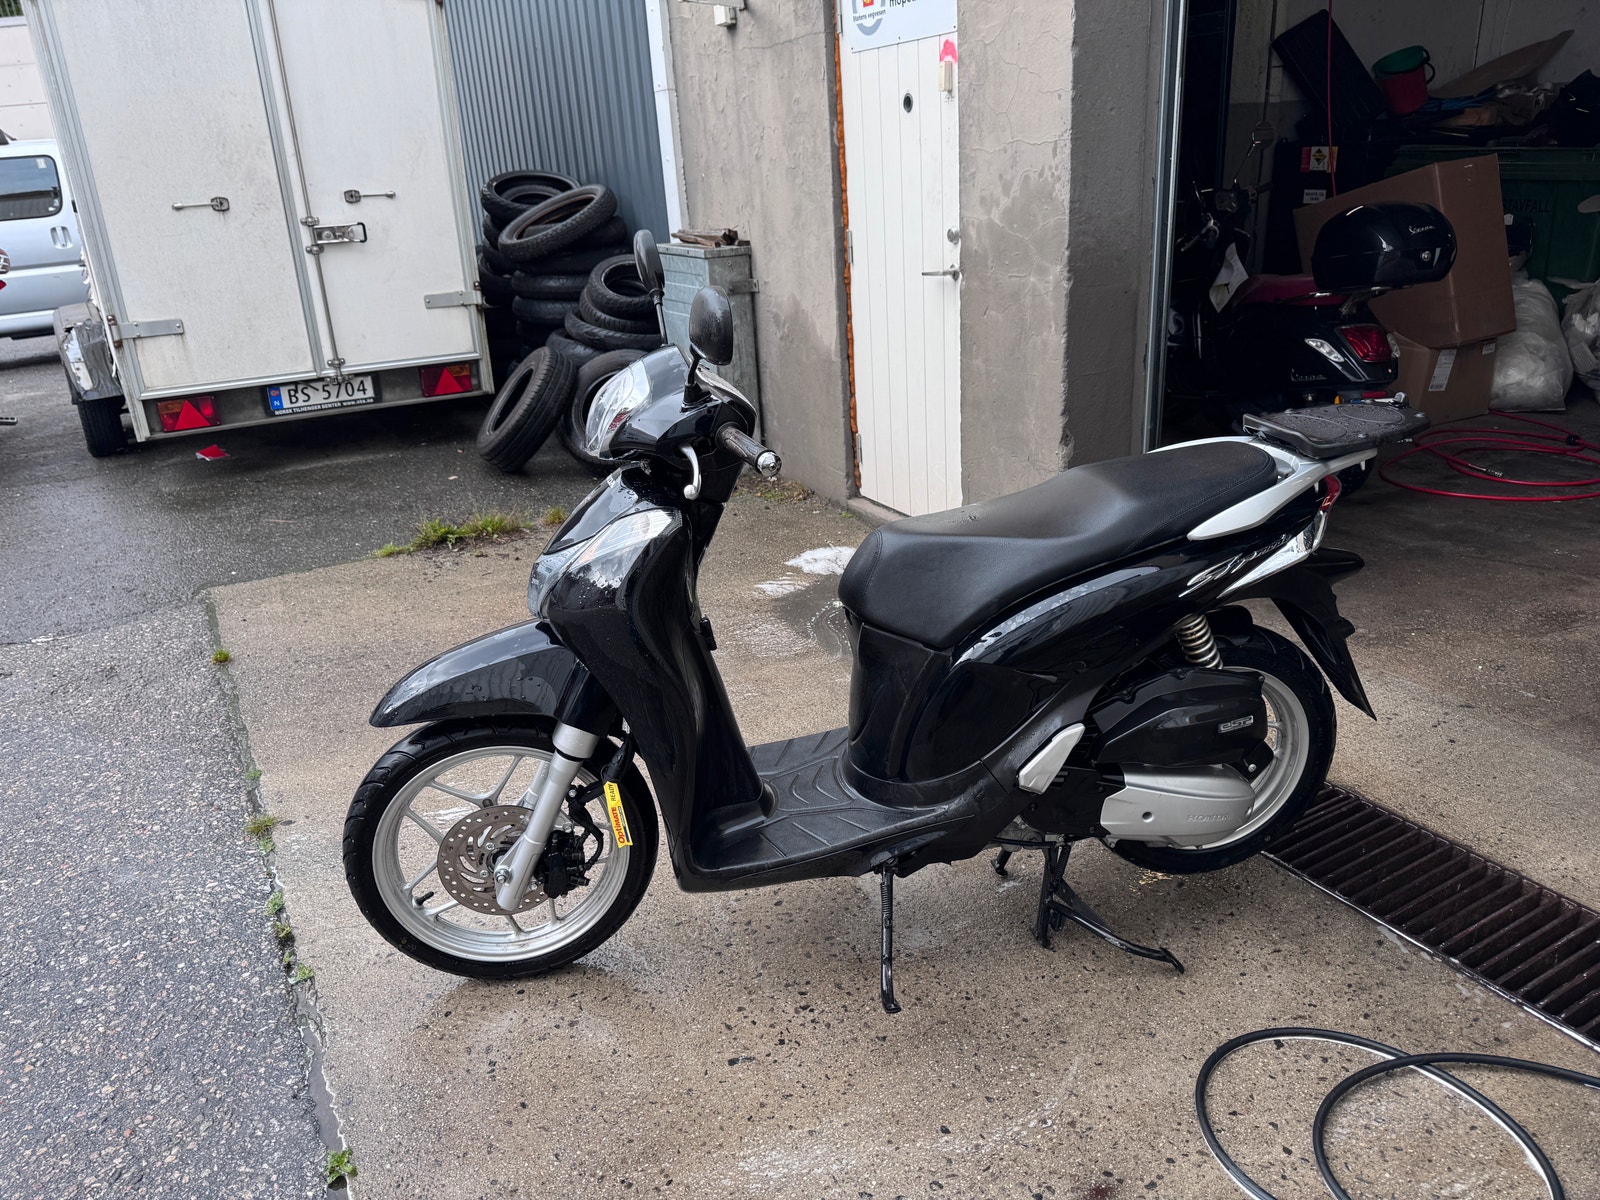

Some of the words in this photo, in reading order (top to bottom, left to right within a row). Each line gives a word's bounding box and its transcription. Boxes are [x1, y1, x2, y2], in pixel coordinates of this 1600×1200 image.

[288, 387, 311, 404] BS
[322, 380, 367, 400] 5704
[293, 404, 321, 413] TILHENGER
[607, 784, 616, 801] READY
[1187, 814, 1229, 822] HONDA
